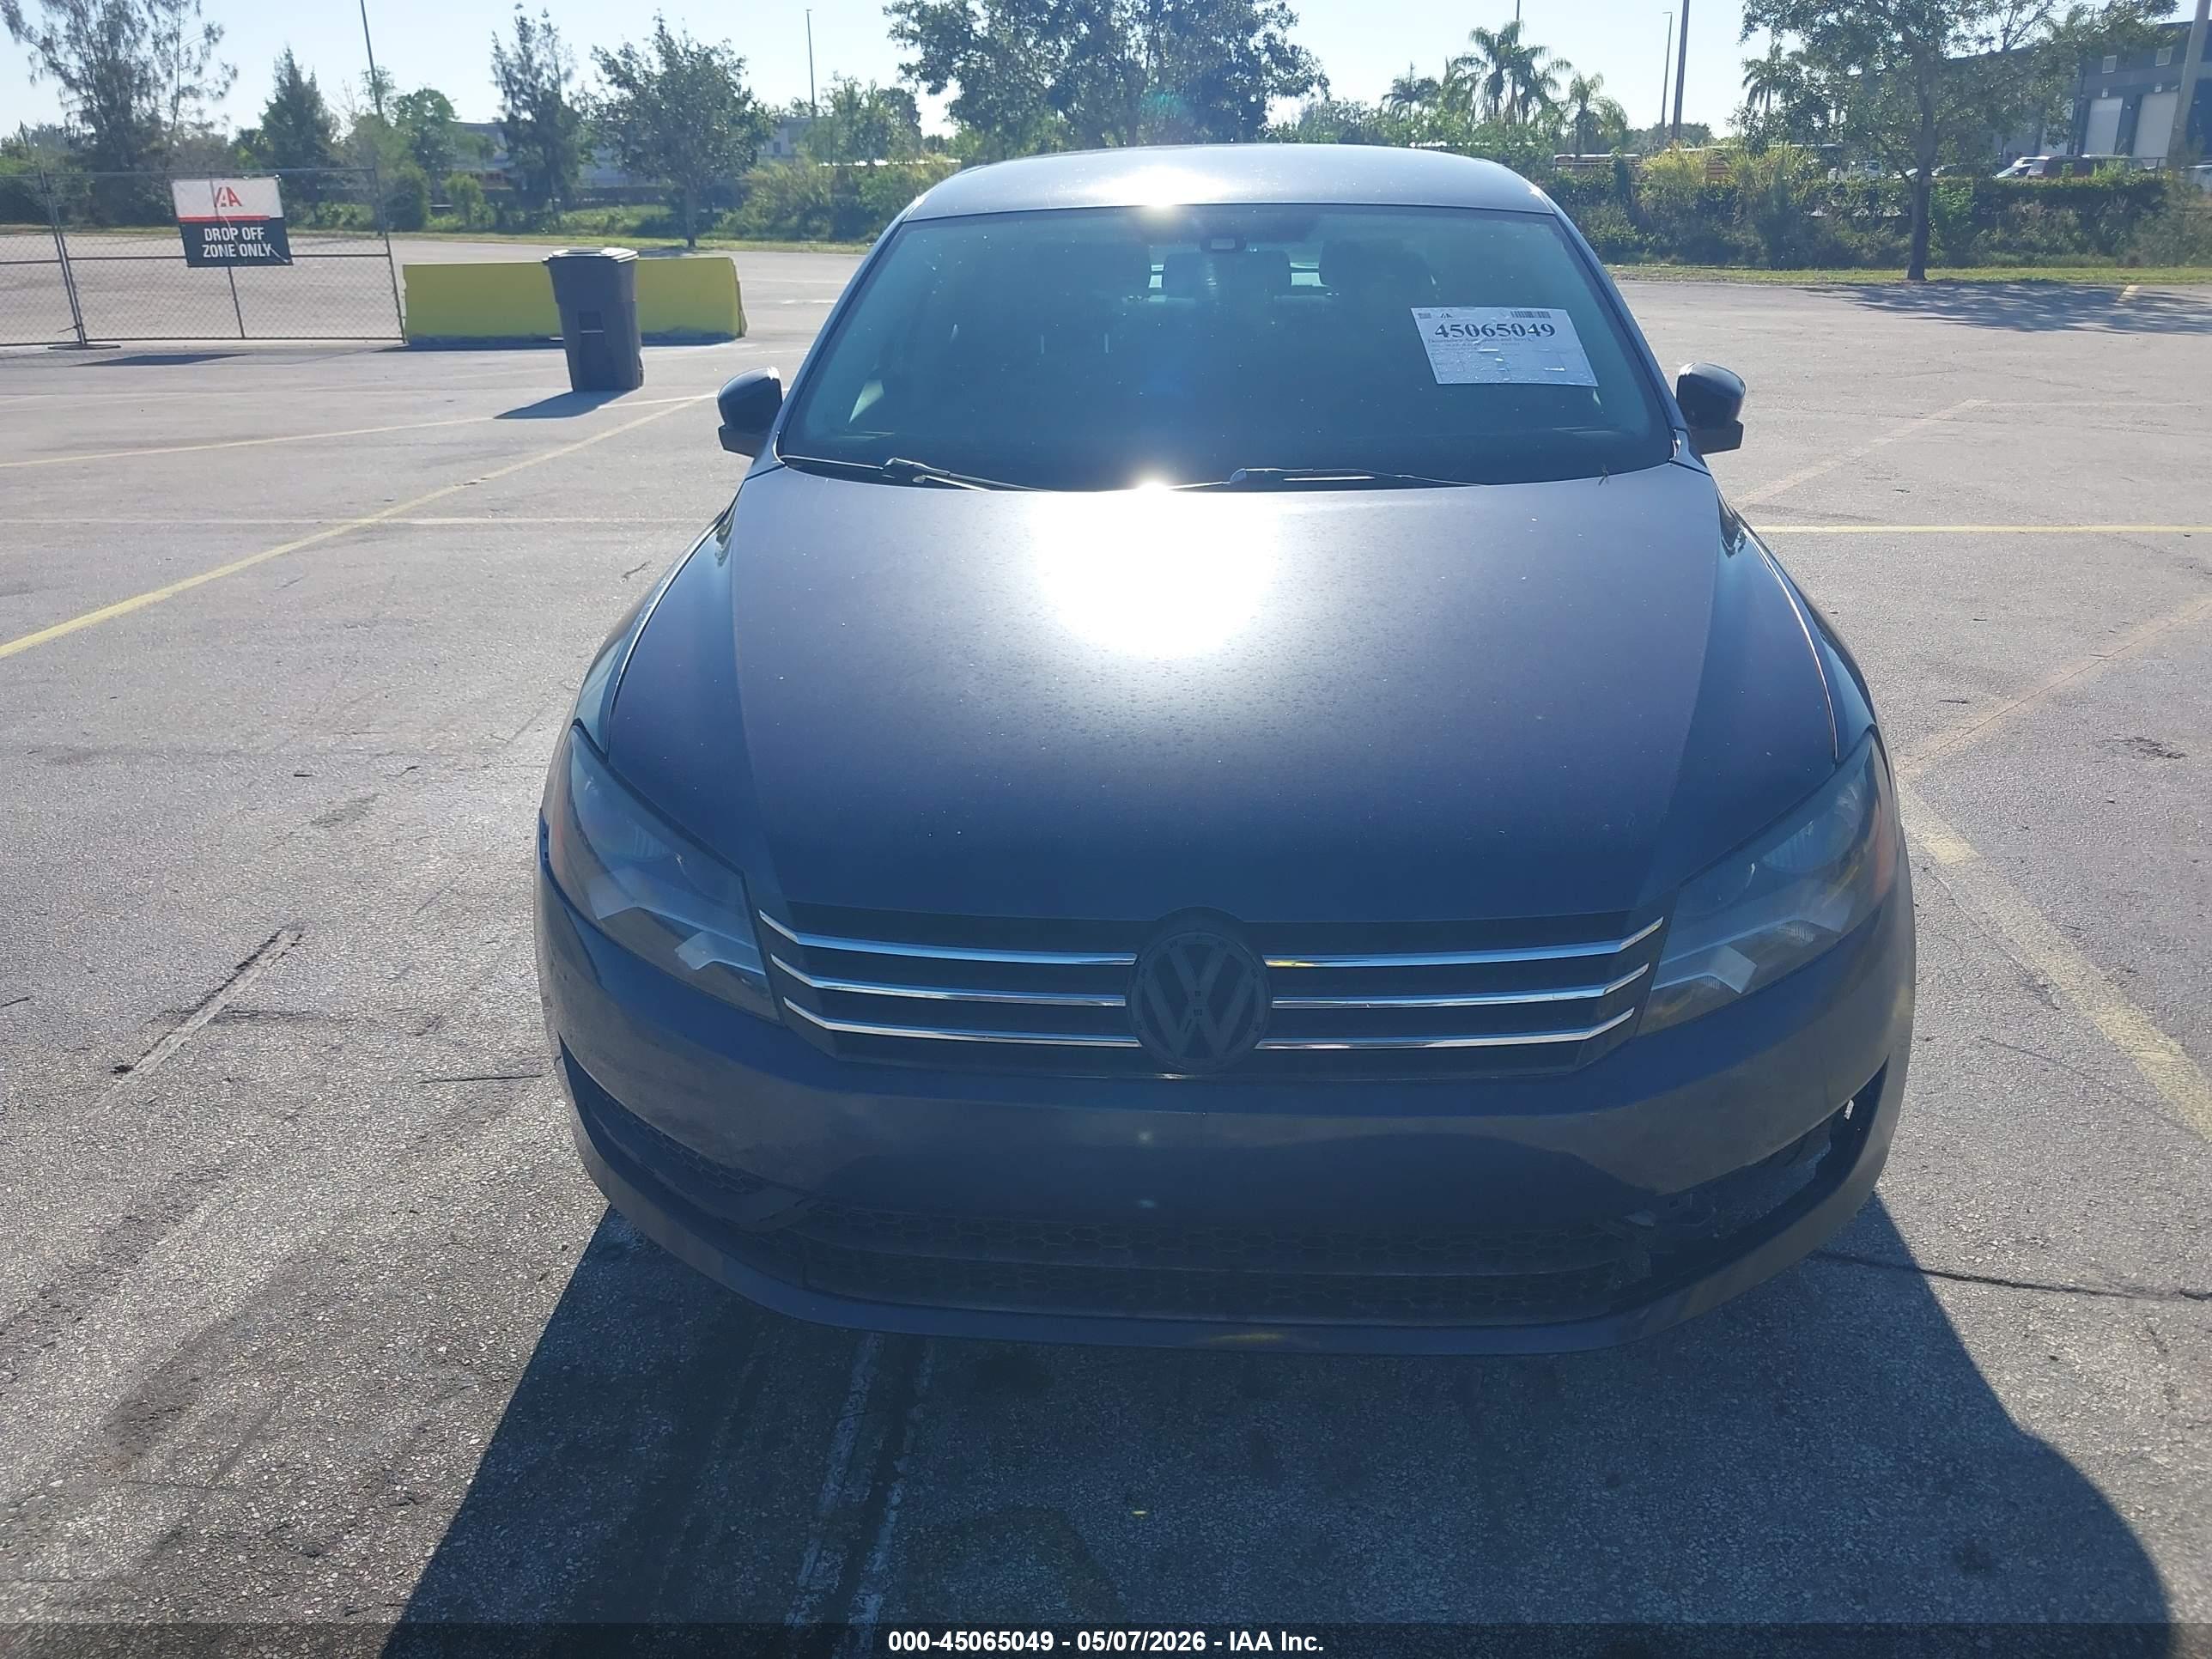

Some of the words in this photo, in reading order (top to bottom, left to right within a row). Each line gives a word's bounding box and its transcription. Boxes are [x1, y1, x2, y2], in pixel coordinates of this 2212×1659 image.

[204, 228, 239, 241] DROP
[241, 227, 264, 240] OFF
[202, 244, 236, 258] ZONE
[239, 243, 271, 257] ONLY
[1434, 323, 1556, 338] 45065049
